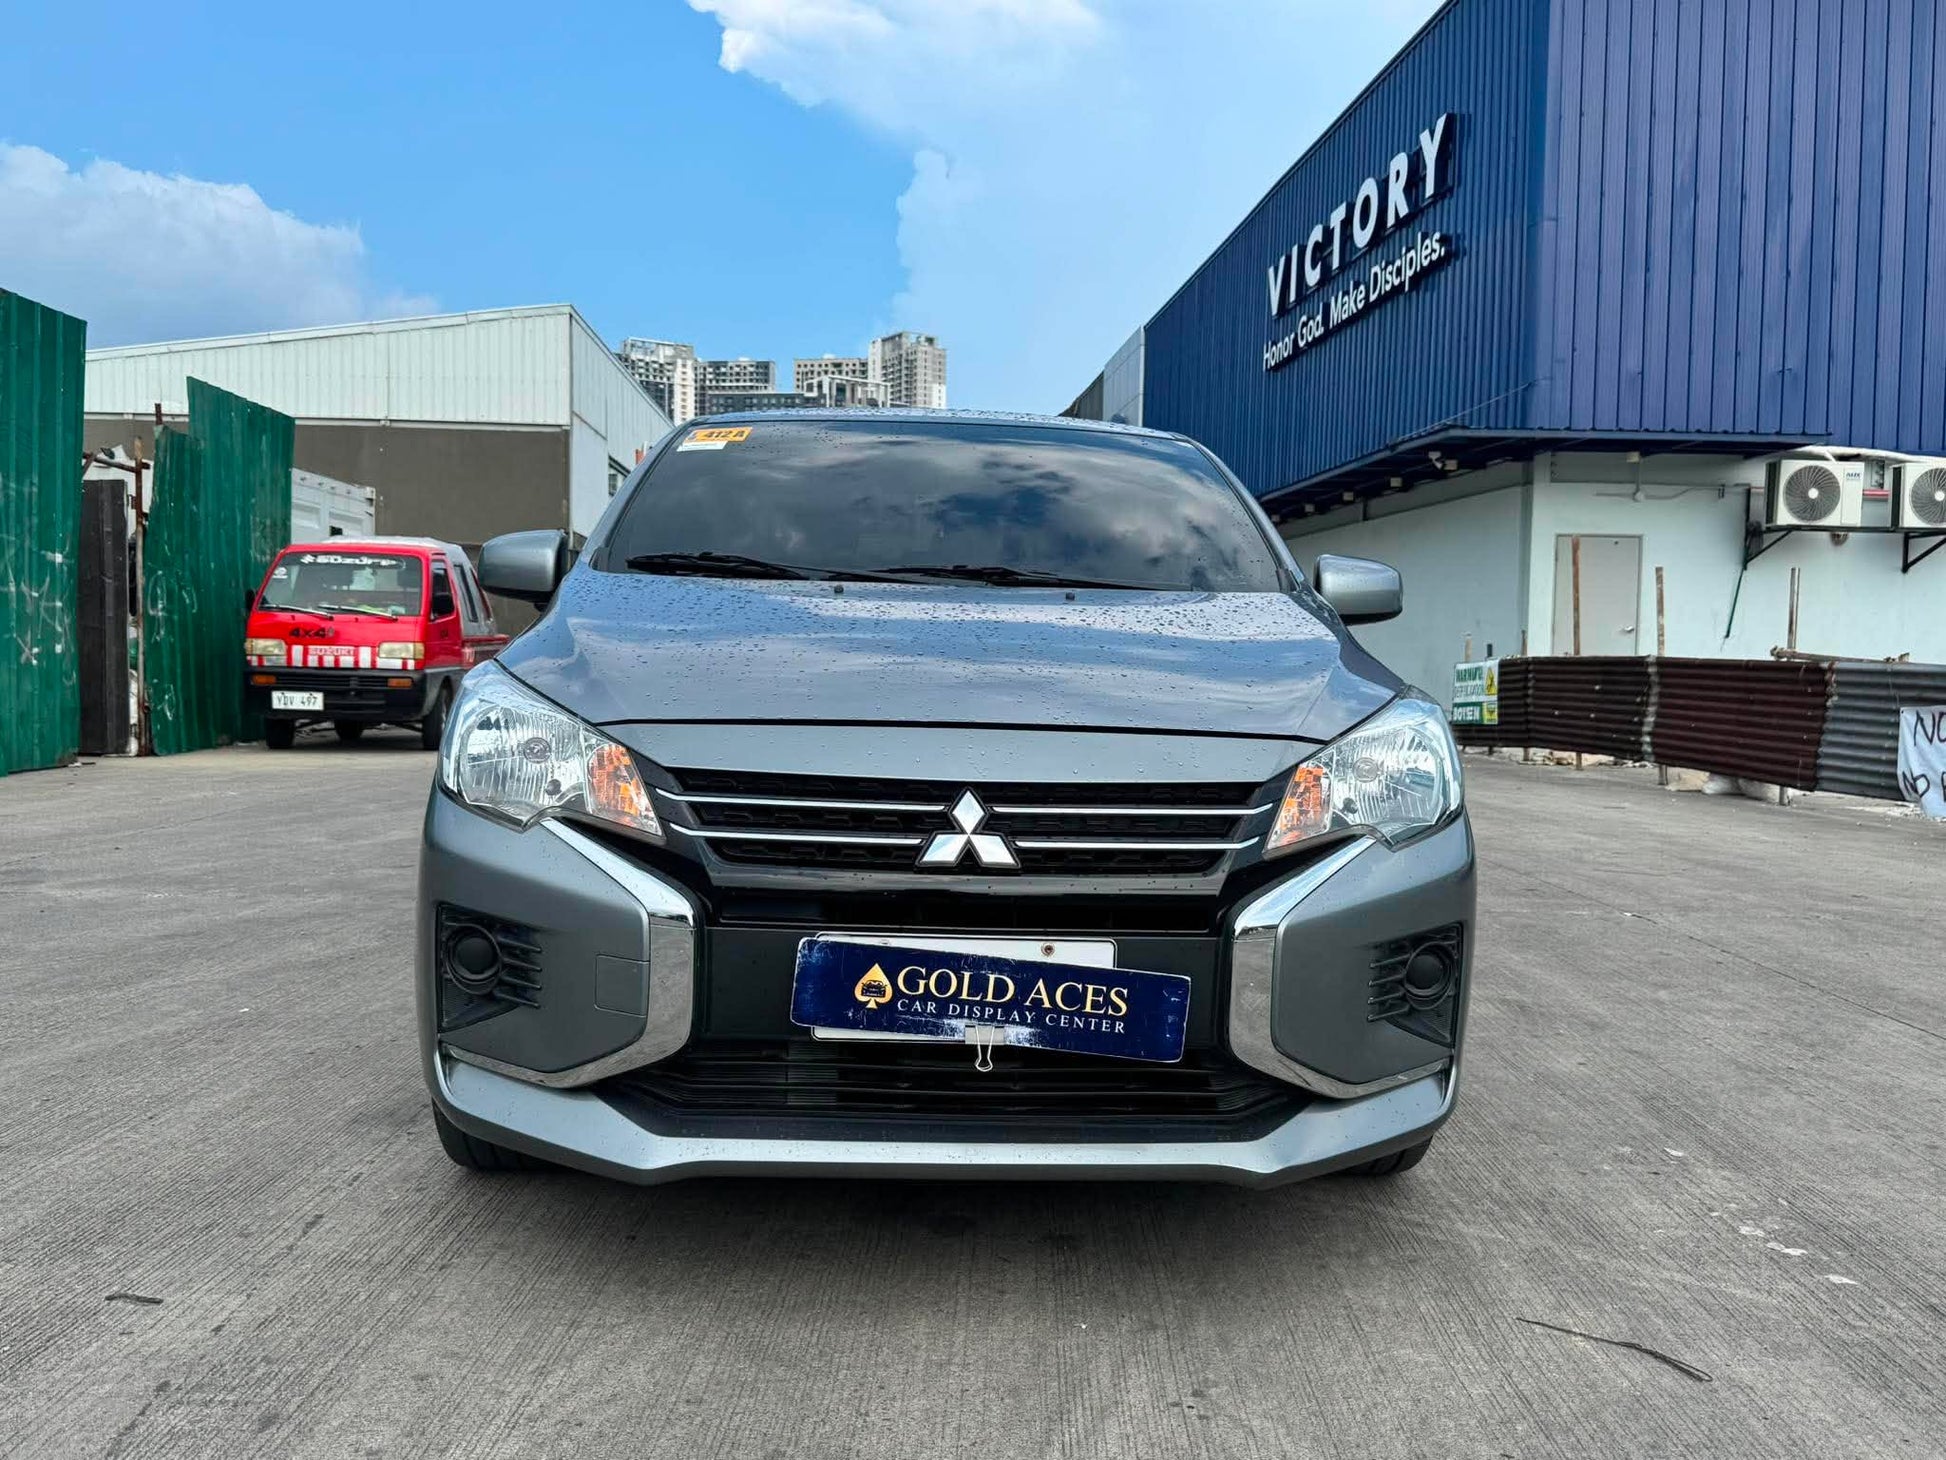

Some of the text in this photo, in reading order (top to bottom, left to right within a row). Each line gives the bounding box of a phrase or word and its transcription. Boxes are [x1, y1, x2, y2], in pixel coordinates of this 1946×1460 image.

[1268, 112, 1448, 316] VICTORY
[1262, 231, 1446, 372] Honor God. Make Disciples.
[897, 965, 1129, 1017] GOLD ACES
[897, 999, 1126, 1035] CAR DISPLAY CENTER
